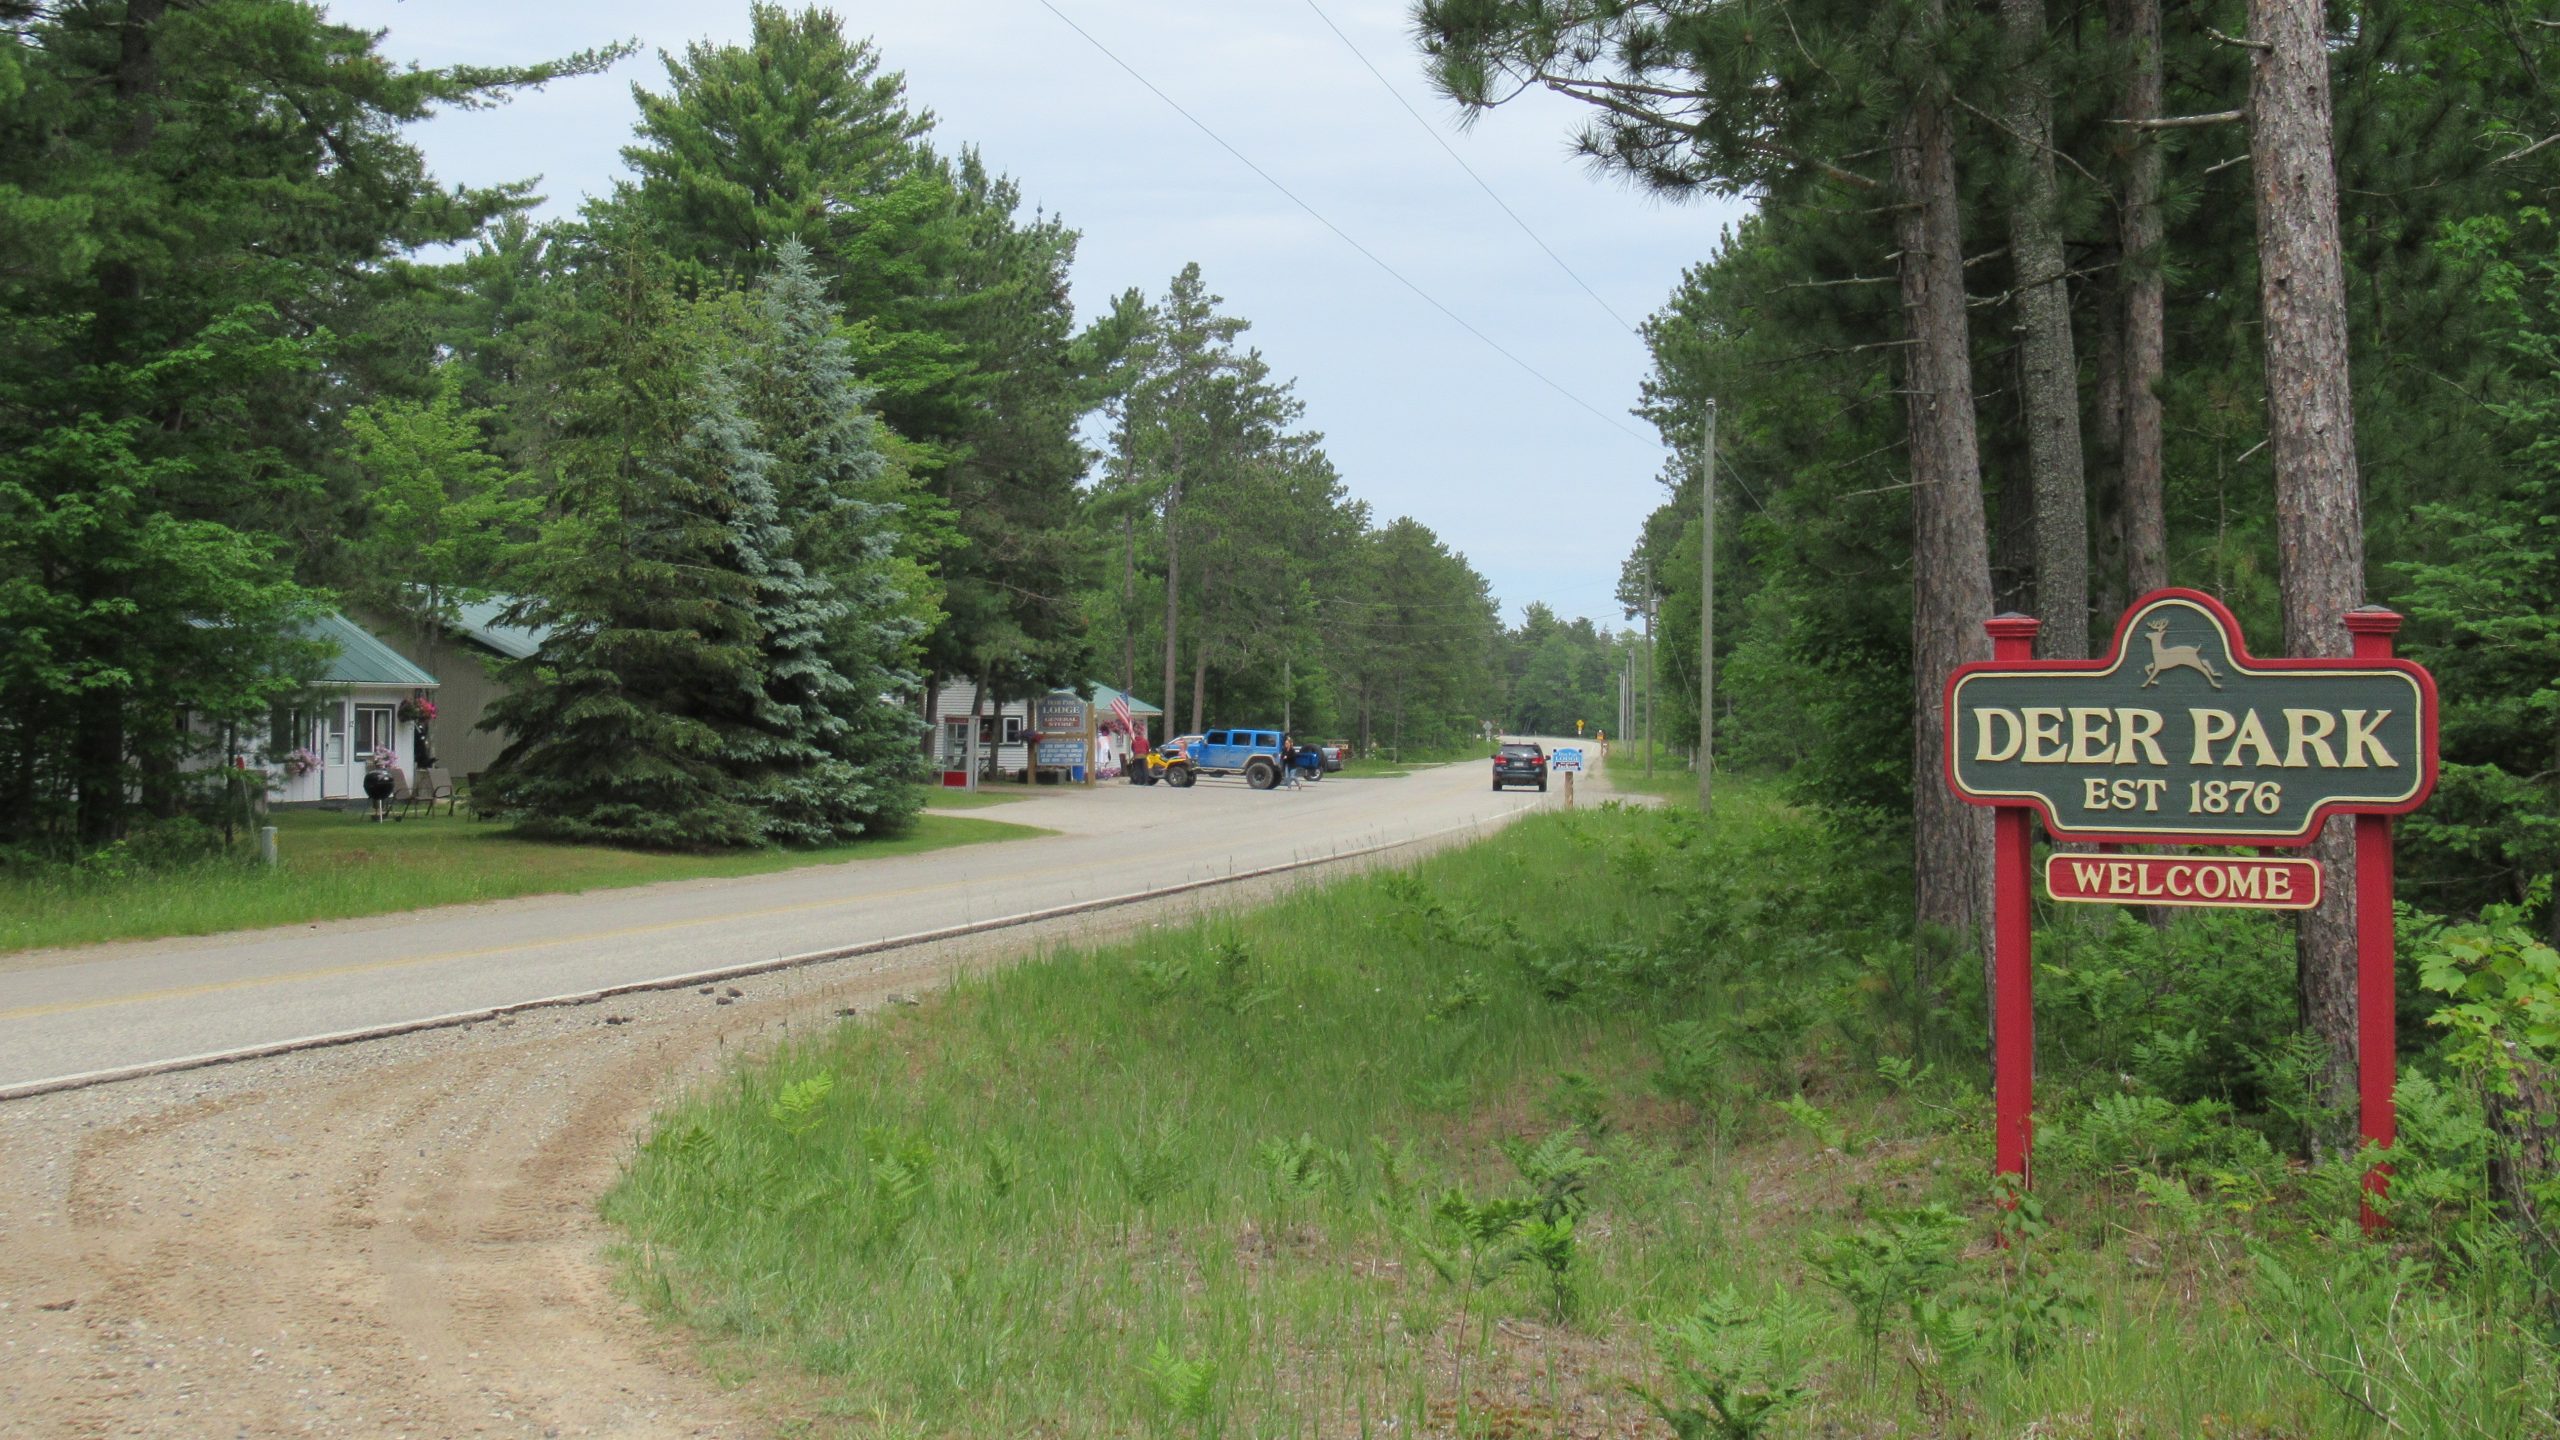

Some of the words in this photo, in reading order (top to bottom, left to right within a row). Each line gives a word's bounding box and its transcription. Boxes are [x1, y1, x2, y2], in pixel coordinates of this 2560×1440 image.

[1043, 706, 1080, 714] LODGE
[1973, 707, 2168, 766] DEER
[2189, 707, 2399, 768] PARK
[2083, 778, 2167, 811] EST
[2189, 780, 2282, 814] 1876
[2072, 862, 2294, 900] WELCOME
